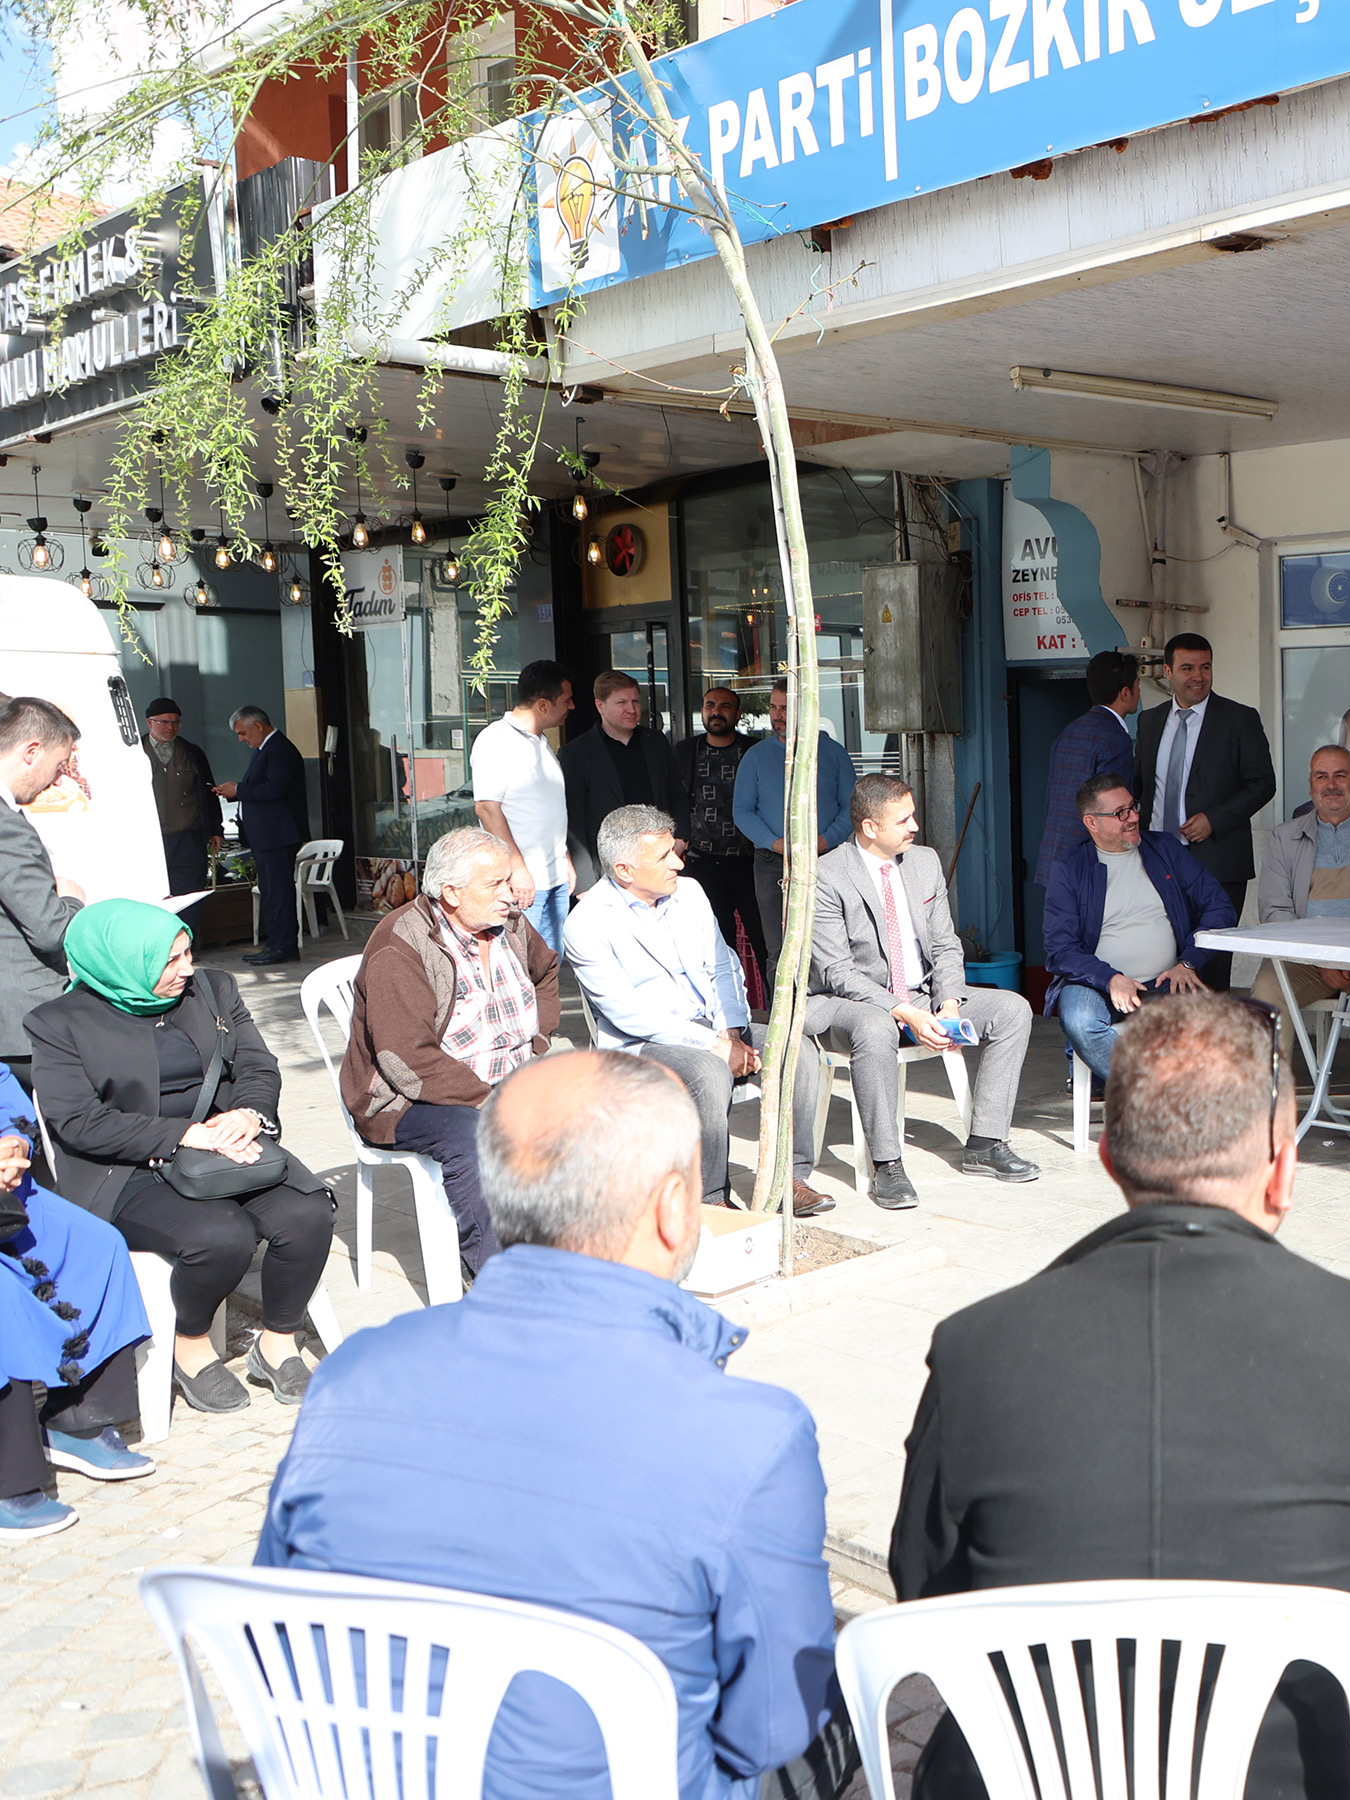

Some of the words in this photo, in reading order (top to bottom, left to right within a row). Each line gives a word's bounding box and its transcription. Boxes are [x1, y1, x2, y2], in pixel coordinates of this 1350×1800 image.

[0, 277, 30, 336] AŞ
[1033, 591, 1049, 601] TEL
[1012, 607, 1030, 617] CEP
[1031, 606, 1048, 616] TEL
[1055, 616, 1074, 625] 053
[1036, 634, 1067, 650] KAT
